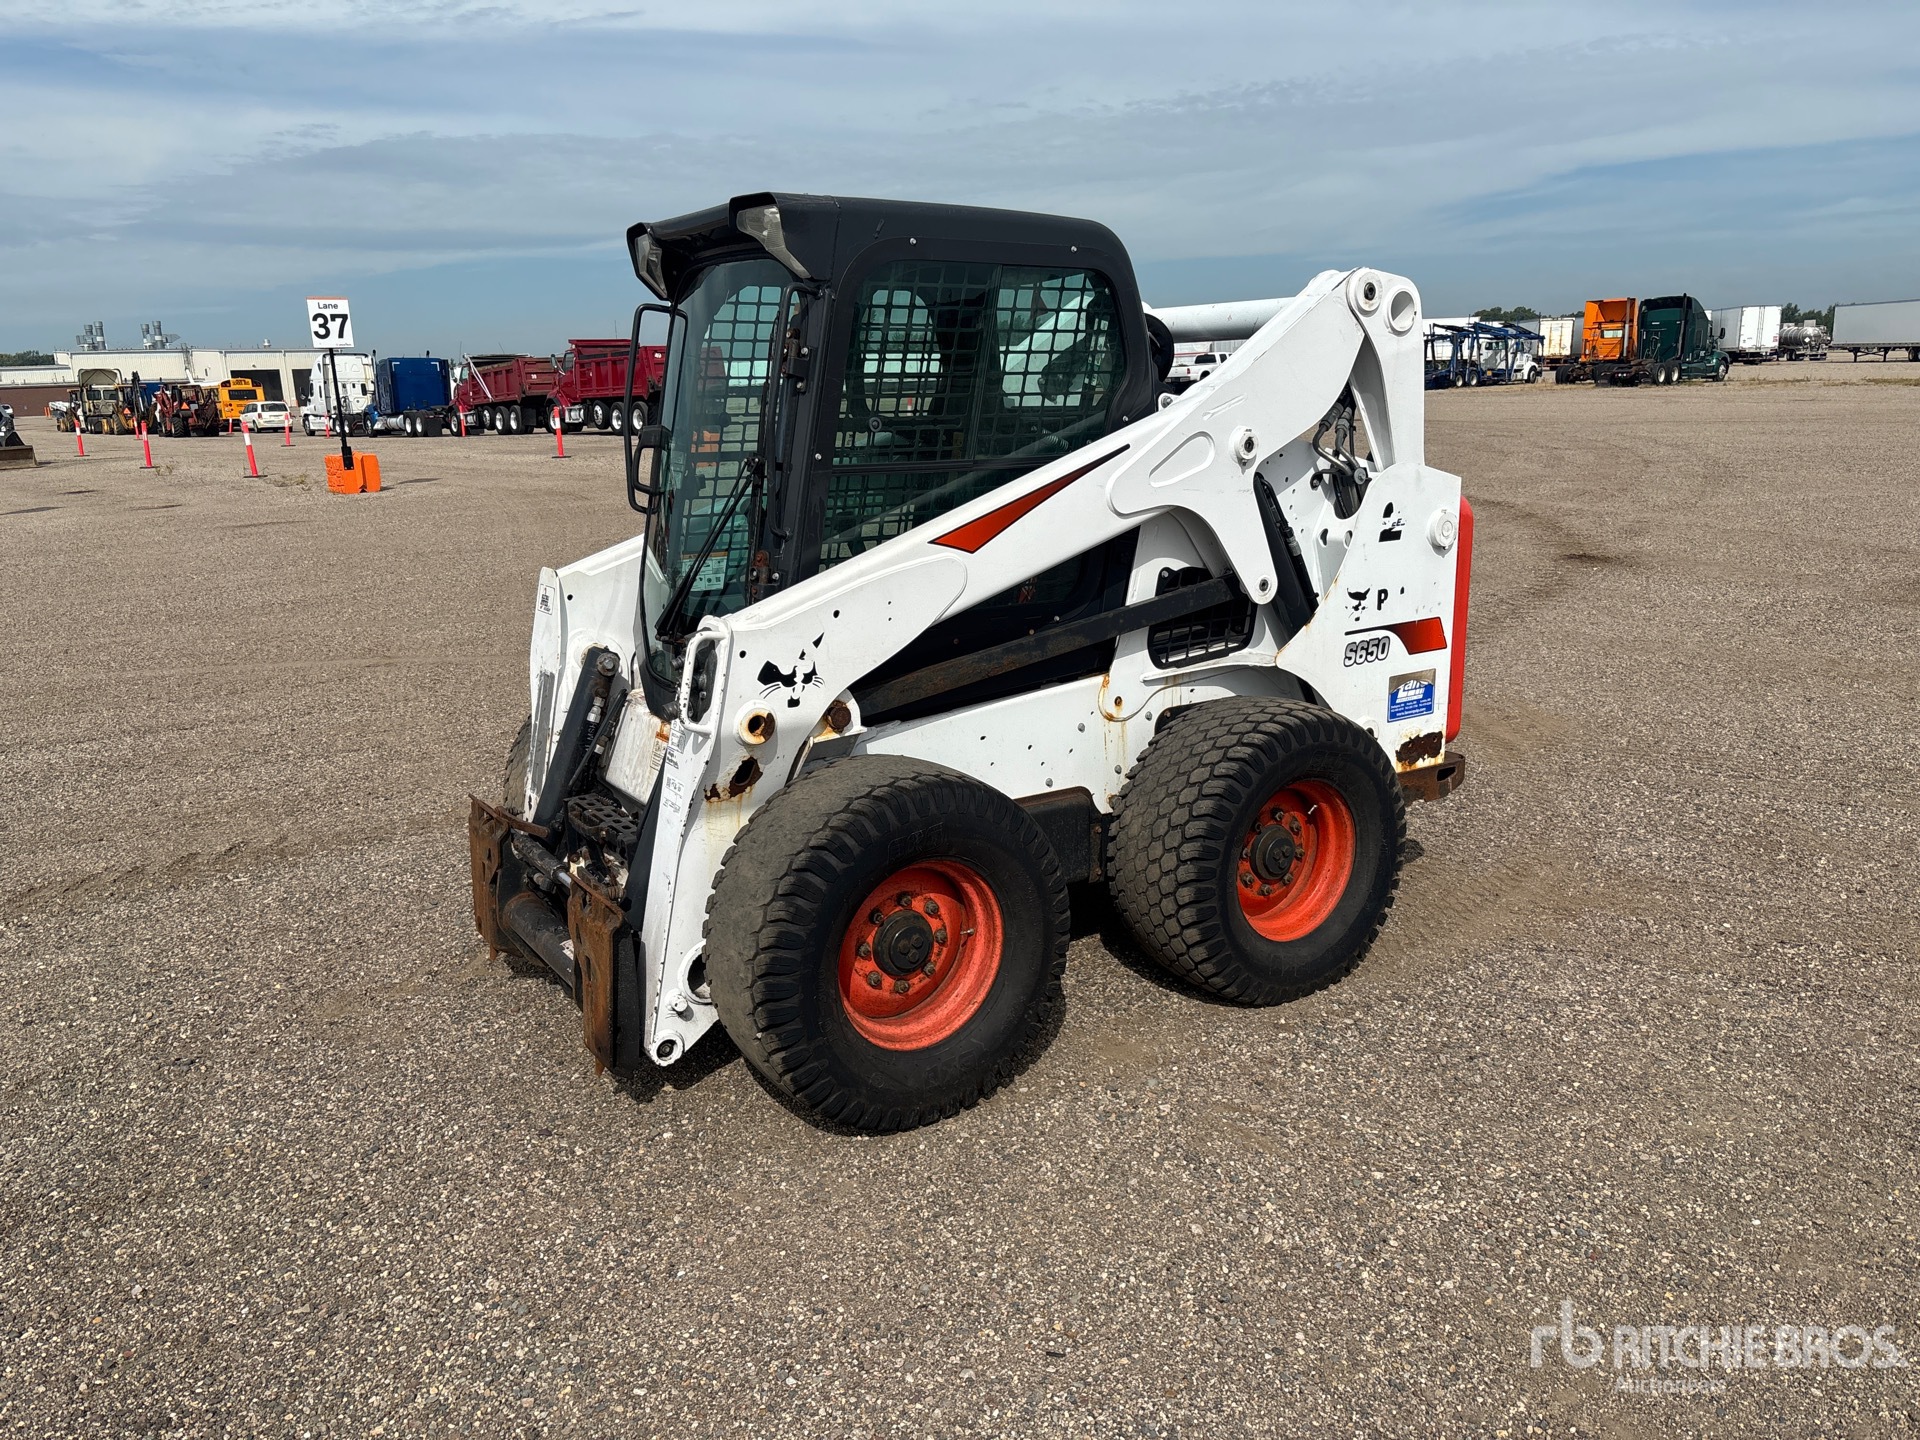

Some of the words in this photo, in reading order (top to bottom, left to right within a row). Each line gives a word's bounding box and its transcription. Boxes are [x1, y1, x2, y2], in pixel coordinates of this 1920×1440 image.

[317, 302, 339, 310] Lane
[312, 313, 348, 340] 37
[1343, 636, 1391, 667] S650
